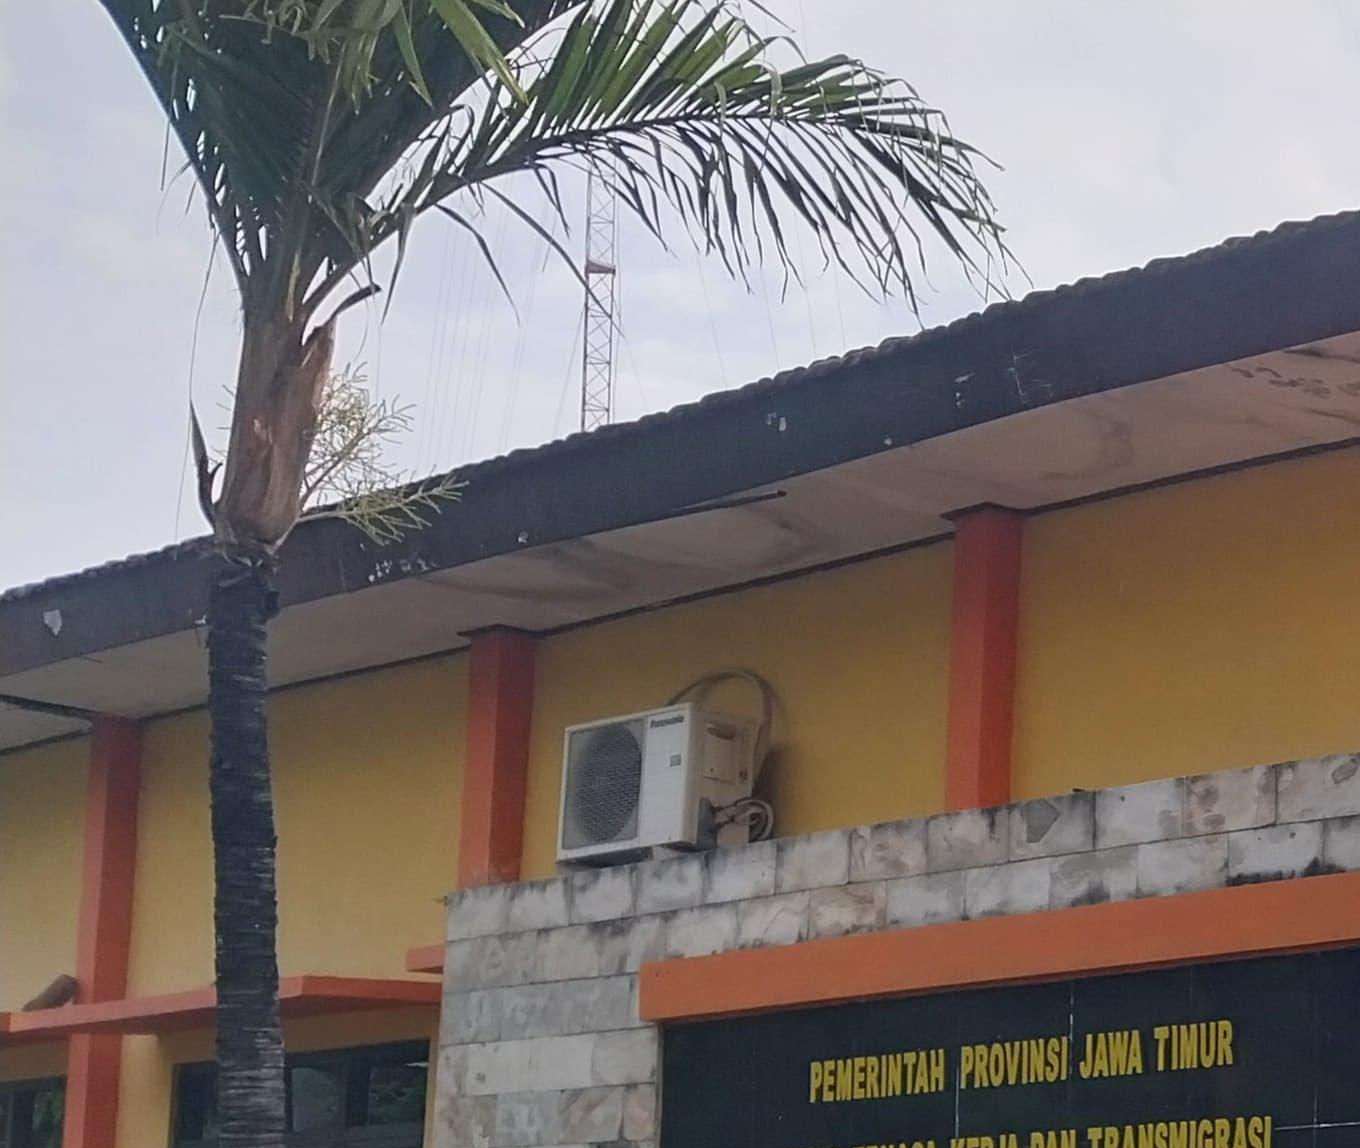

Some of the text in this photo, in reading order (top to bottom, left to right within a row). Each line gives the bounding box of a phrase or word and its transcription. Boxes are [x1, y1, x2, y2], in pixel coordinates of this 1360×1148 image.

[809, 1019, 1233, 1103] PEMERINTAH PROVINSI JAWA TIMUR
